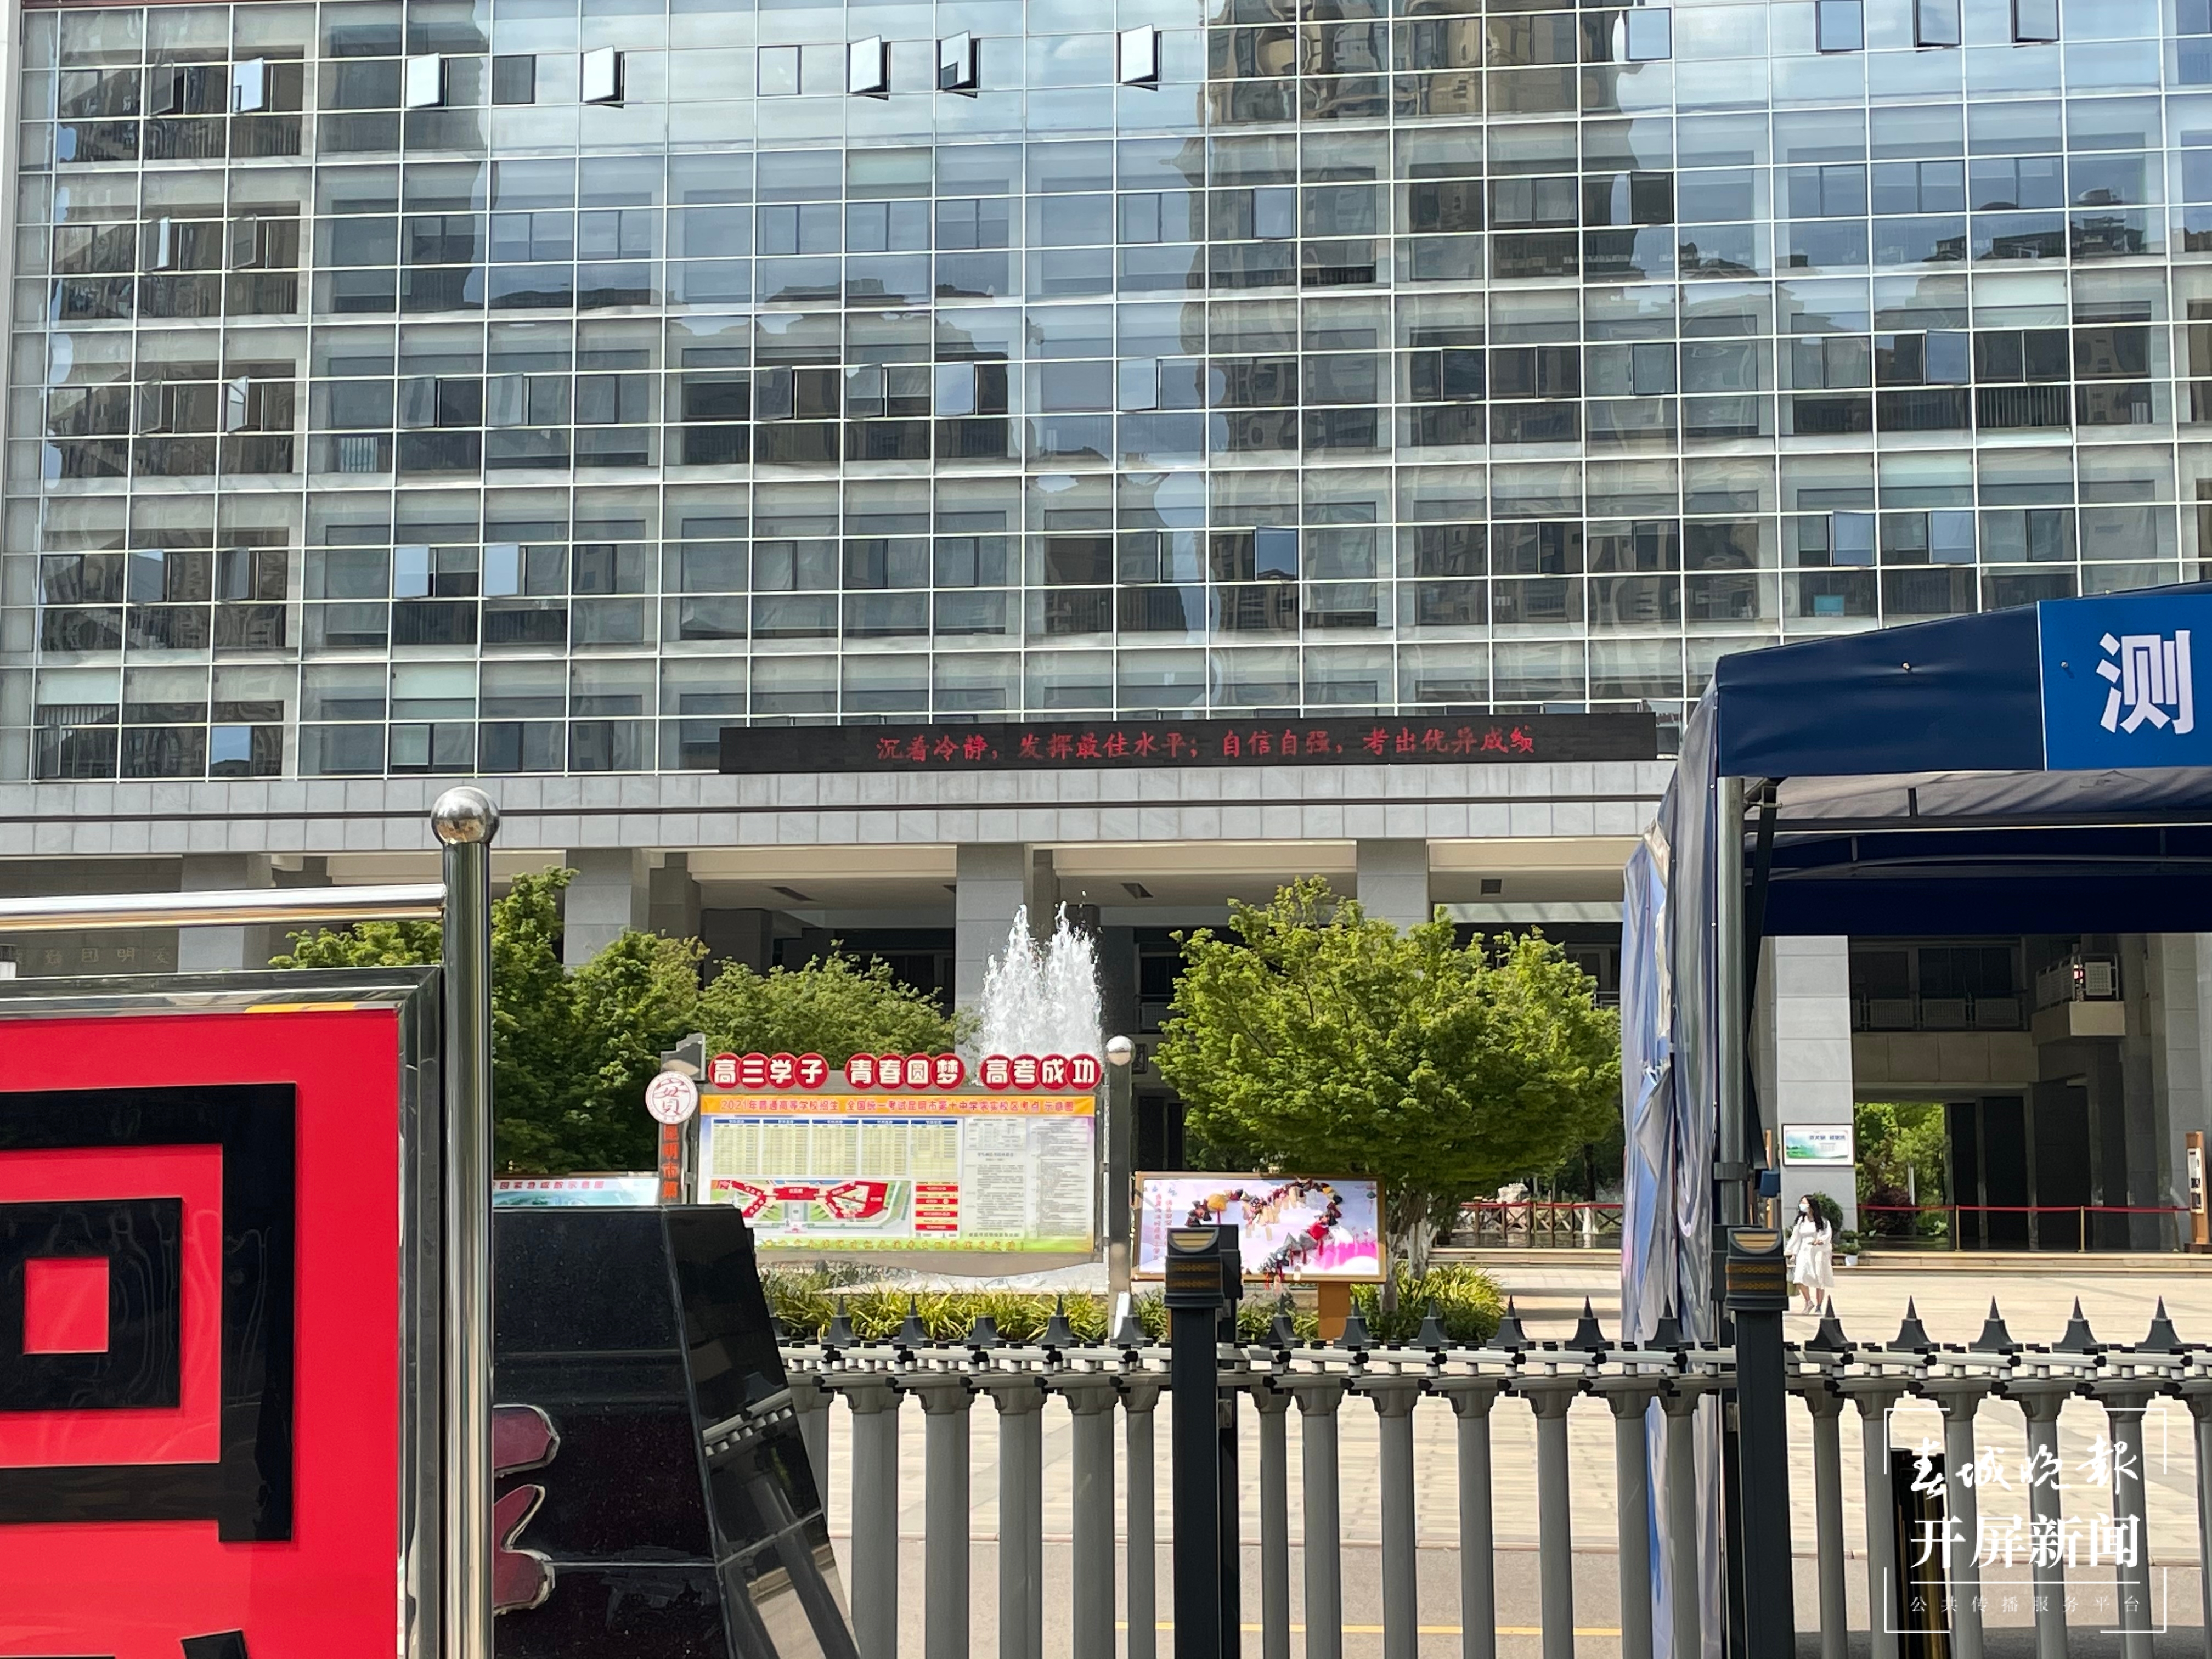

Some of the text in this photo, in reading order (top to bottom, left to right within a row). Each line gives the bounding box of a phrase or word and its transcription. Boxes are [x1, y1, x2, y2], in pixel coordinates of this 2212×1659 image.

[2096, 630, 2195, 735] 测
[714, 1057, 1095, 1085] 高三学子 青春圆梦 高考成功
